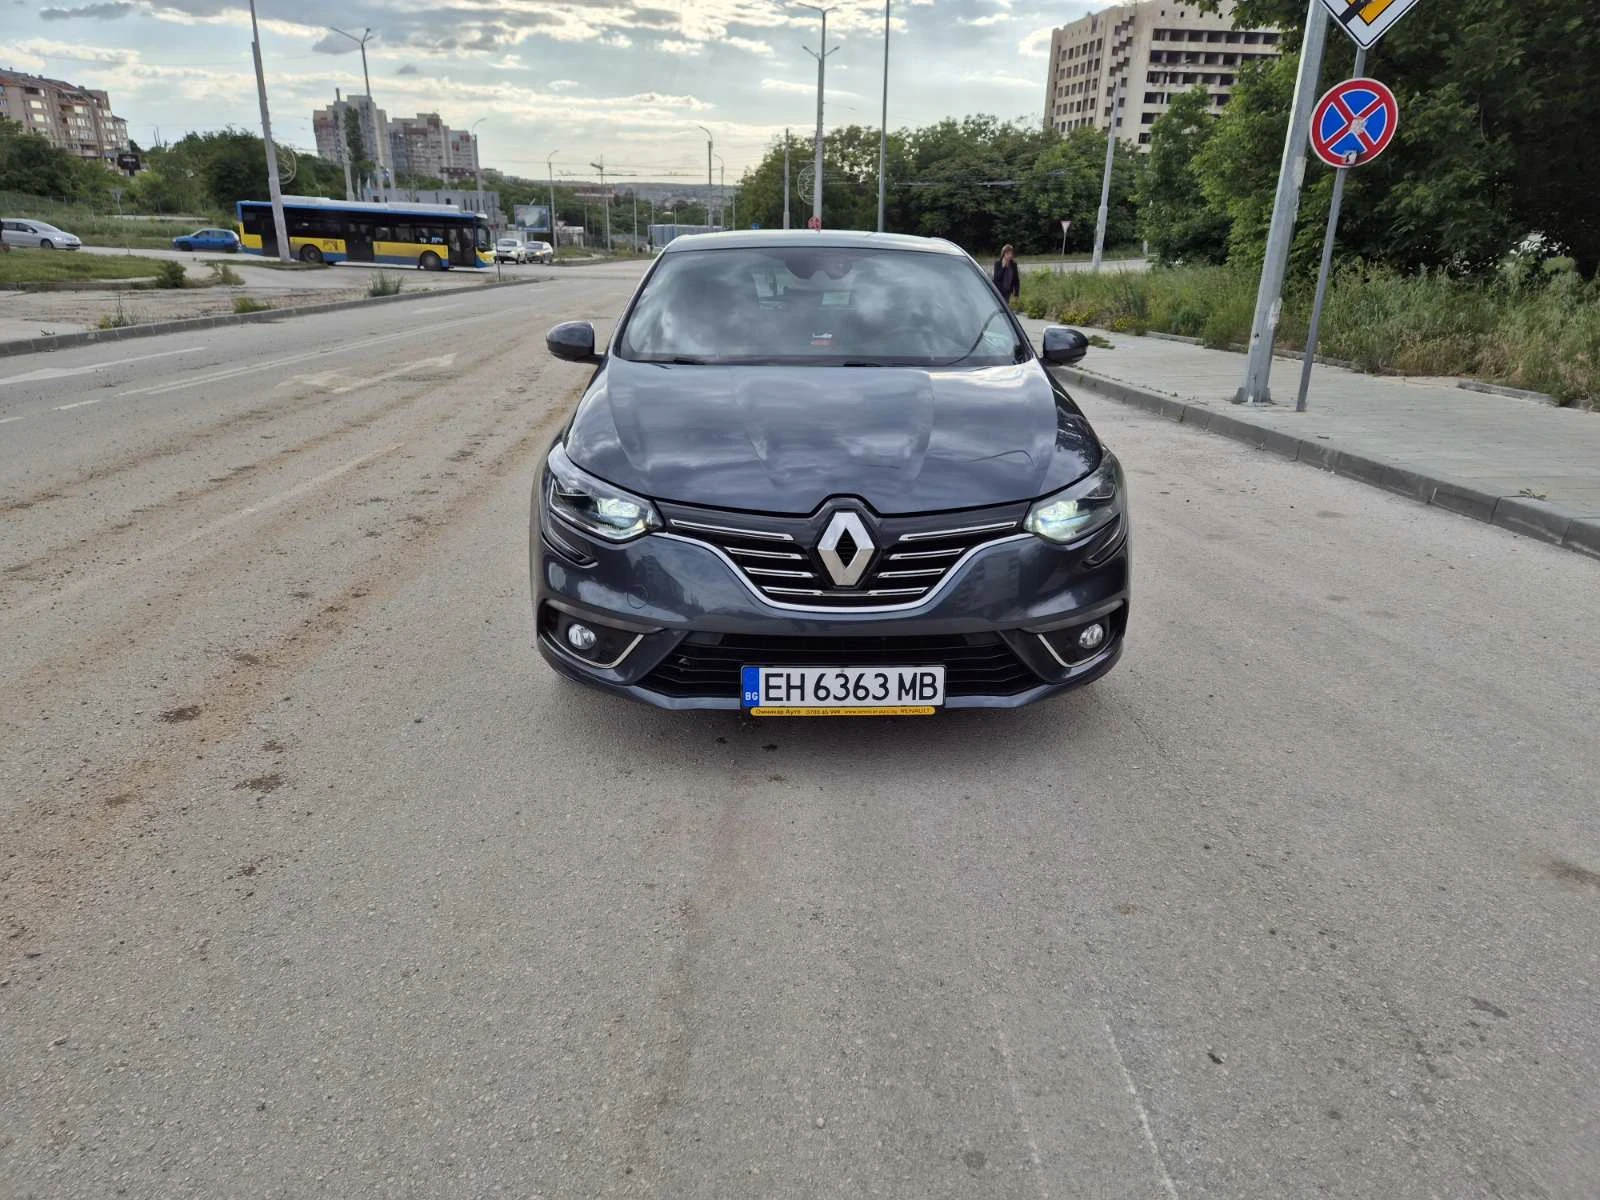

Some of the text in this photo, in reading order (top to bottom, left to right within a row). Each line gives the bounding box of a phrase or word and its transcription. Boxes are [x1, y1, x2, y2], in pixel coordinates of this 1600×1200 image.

[745, 691, 759, 701] BG
[764, 672, 938, 701] EH 6363 MB
